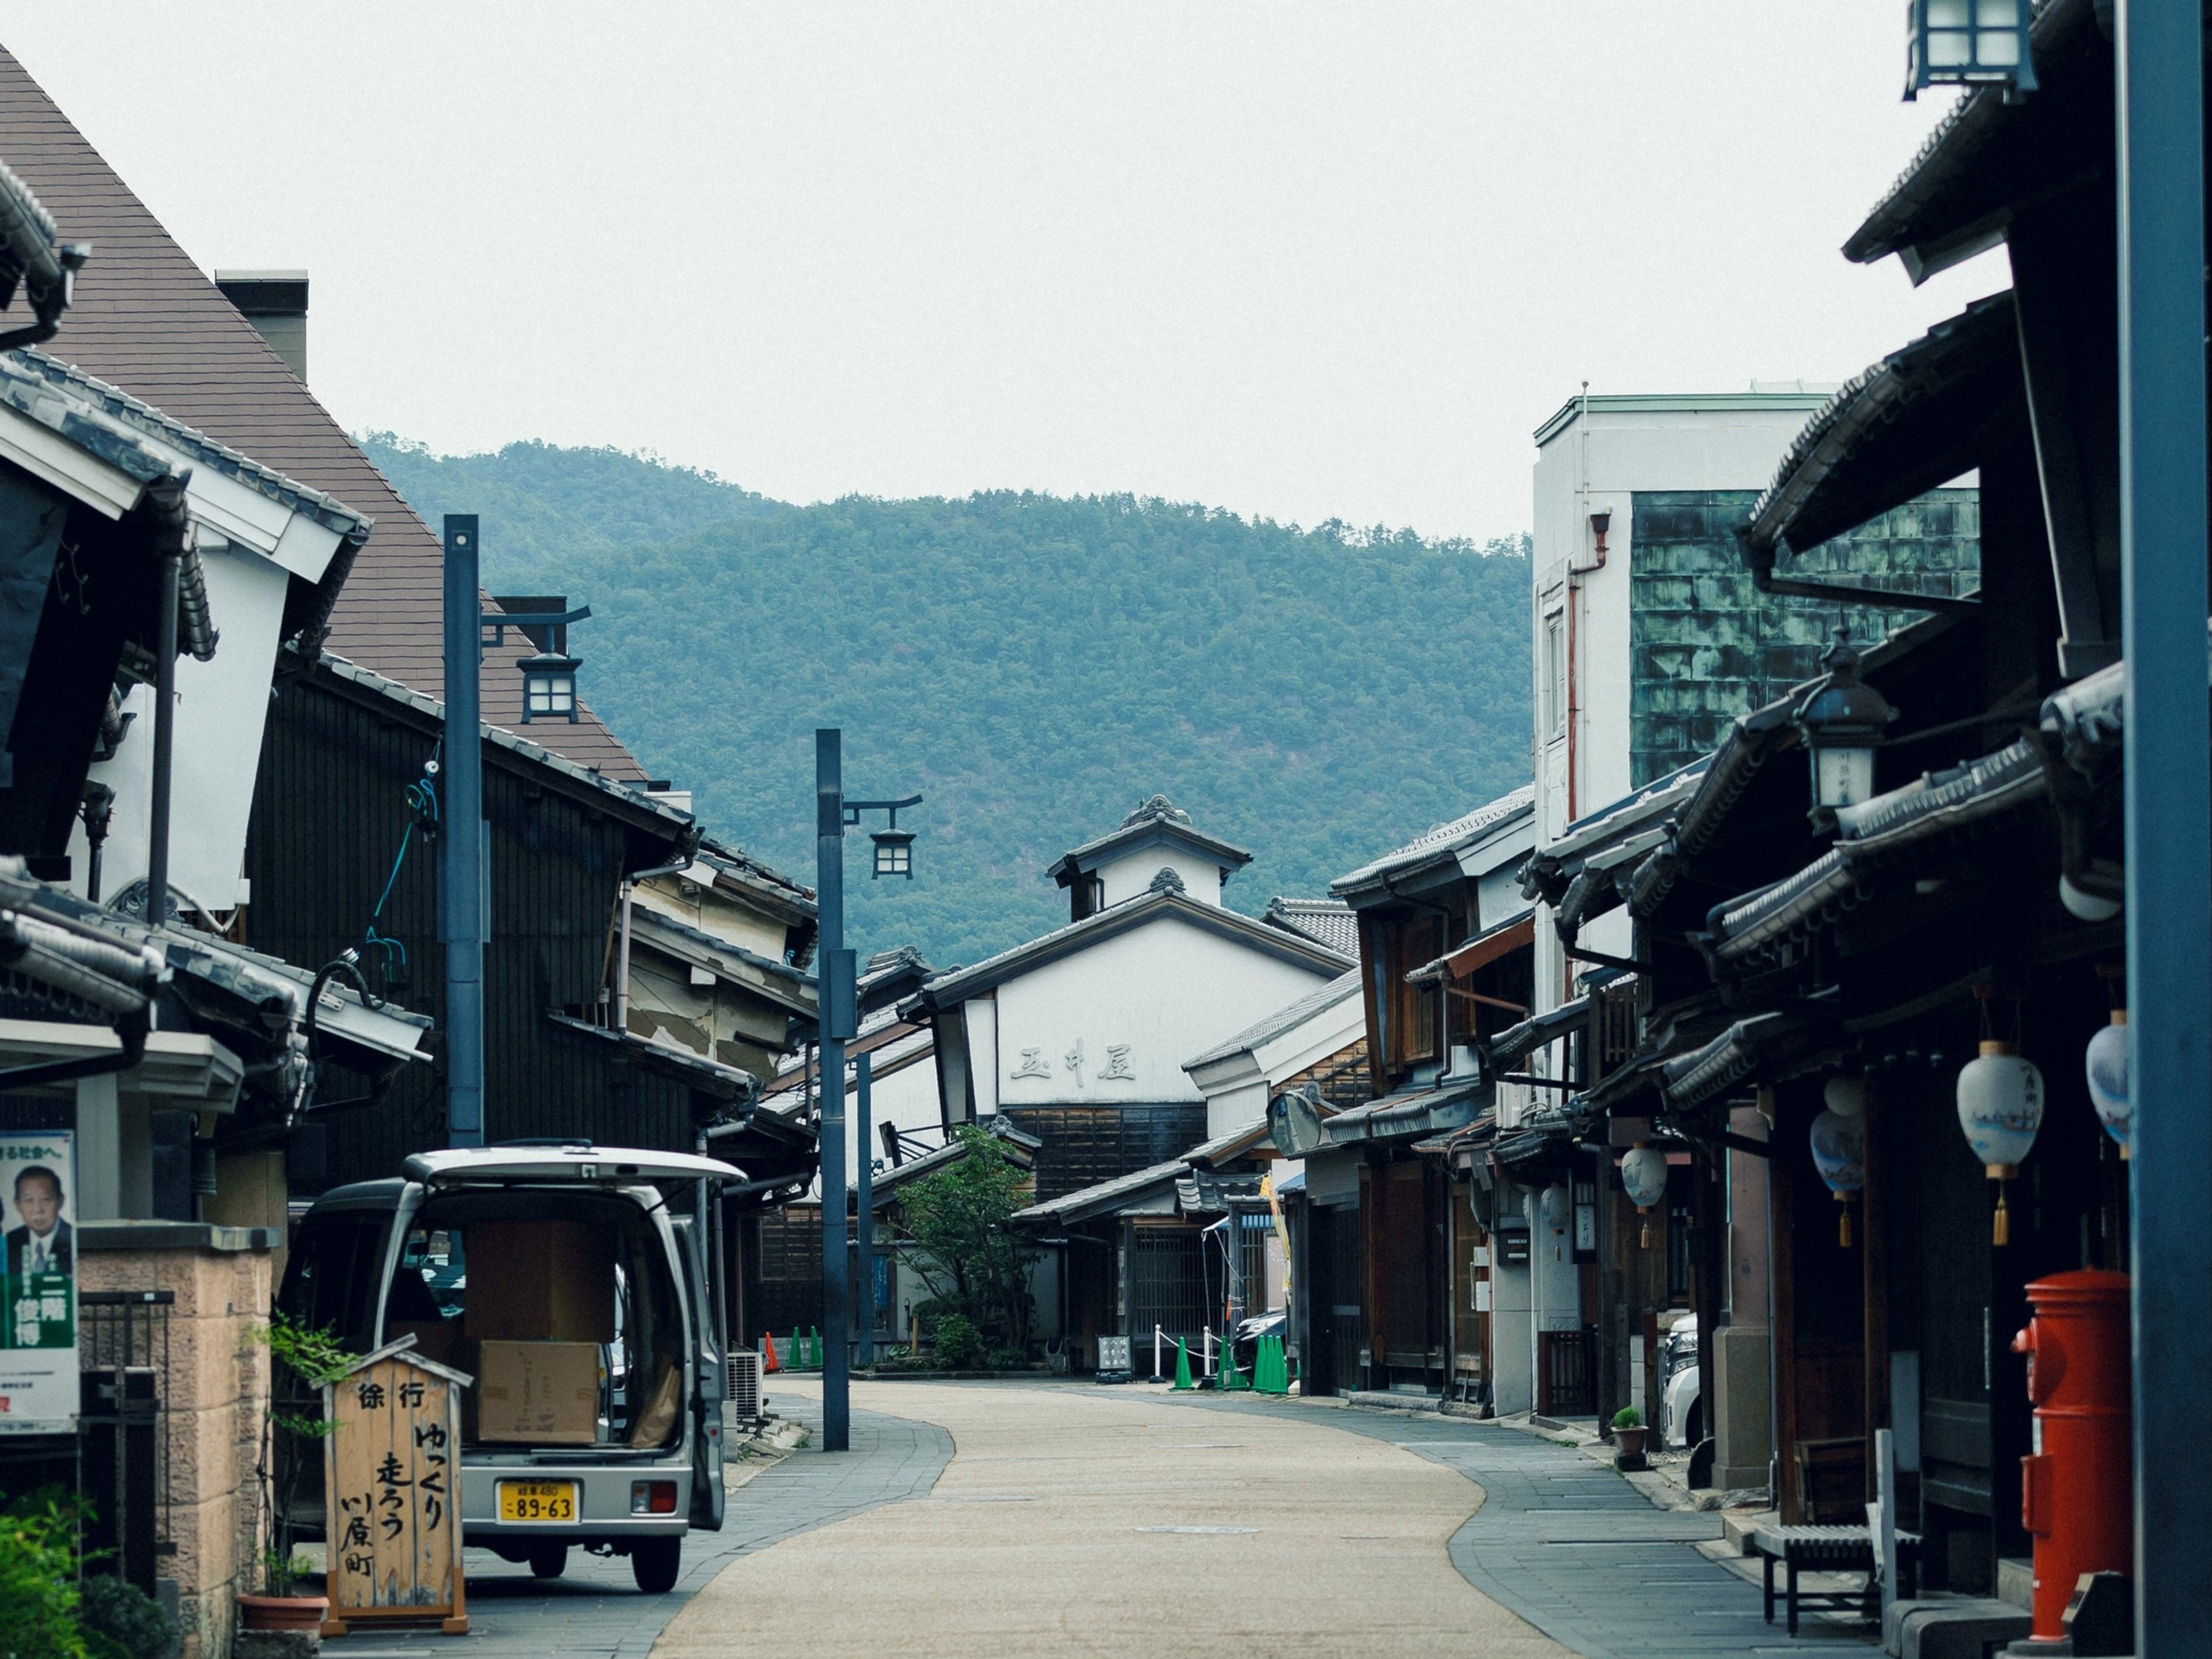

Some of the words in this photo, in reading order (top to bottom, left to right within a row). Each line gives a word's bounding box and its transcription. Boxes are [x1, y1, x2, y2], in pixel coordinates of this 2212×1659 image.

[1011, 1037, 1136, 1088] 玉井屋
[359, 1384, 425, 1410] 徐行
[376, 1451, 413, 1541] 走ろう
[415, 1423, 446, 1532] ゆっくり
[539, 1486, 558, 1496] 480
[517, 1498, 570, 1517] 89-63
[340, 1493, 374, 1577] 川原町
